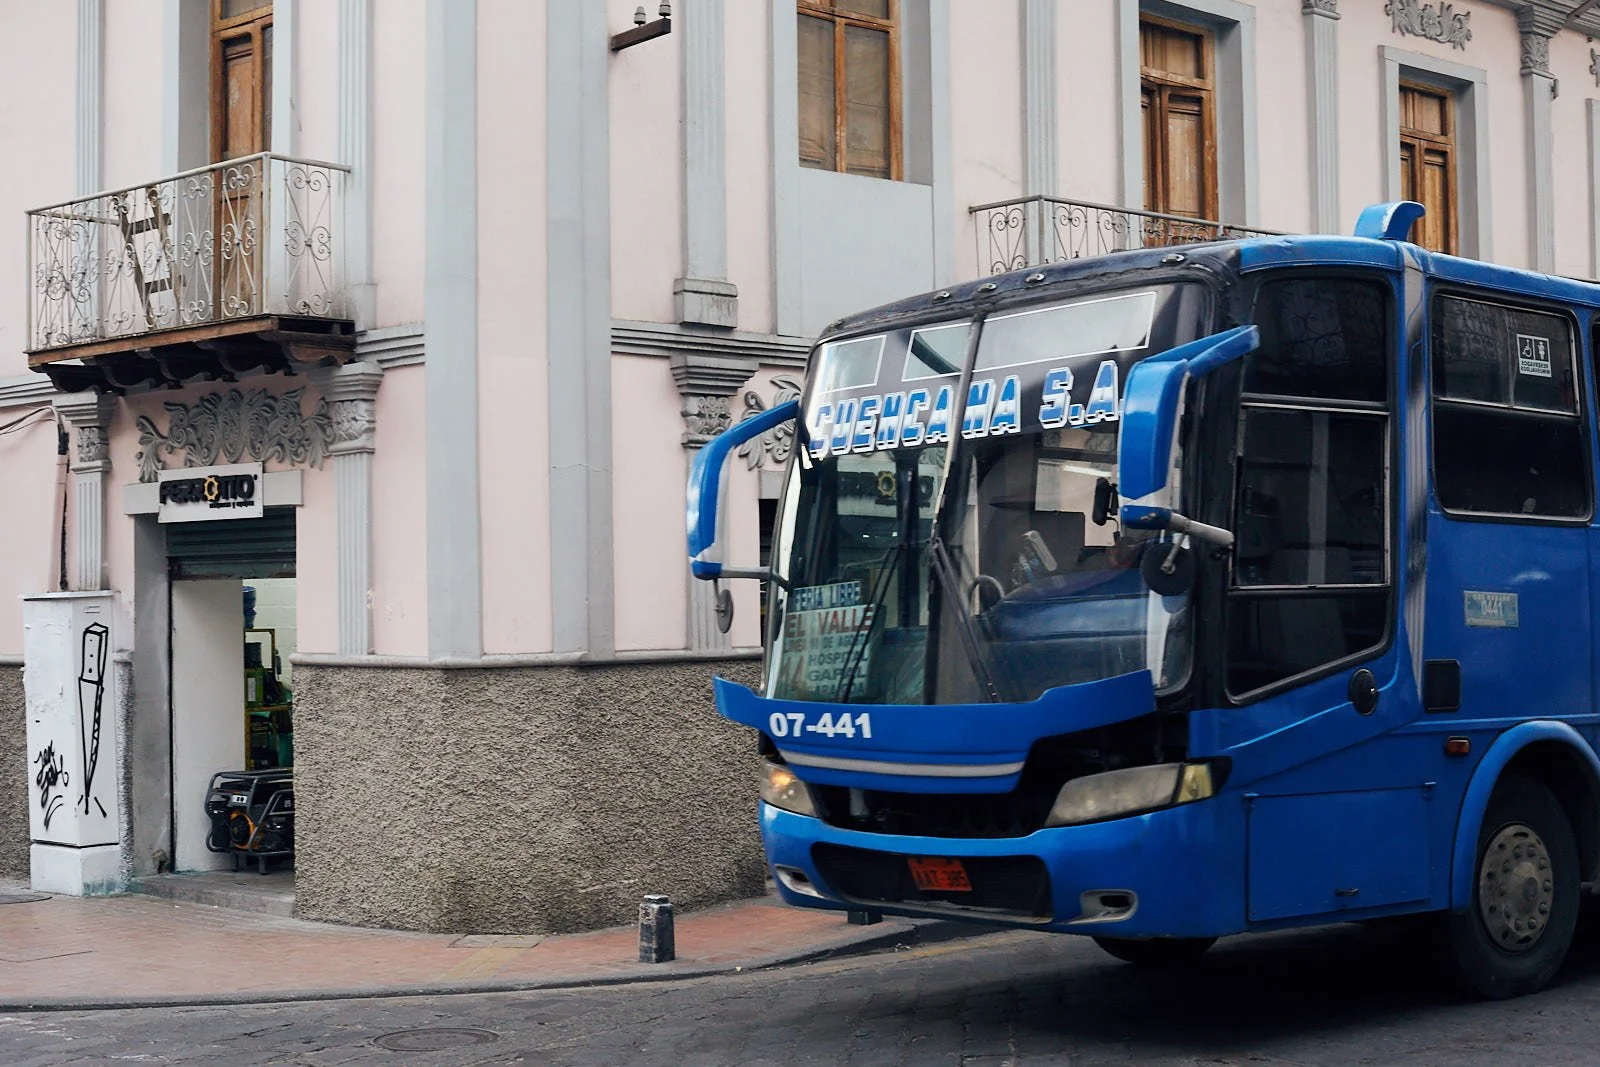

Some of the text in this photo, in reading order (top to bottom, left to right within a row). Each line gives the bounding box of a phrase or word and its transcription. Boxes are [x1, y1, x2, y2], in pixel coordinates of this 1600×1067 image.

[809, 360, 1124, 459] CUENCANA S.A
[794, 582, 861, 612] FERIA LIBRE
[786, 606, 873, 638] EL VALLE
[769, 712, 873, 739] 07-441
